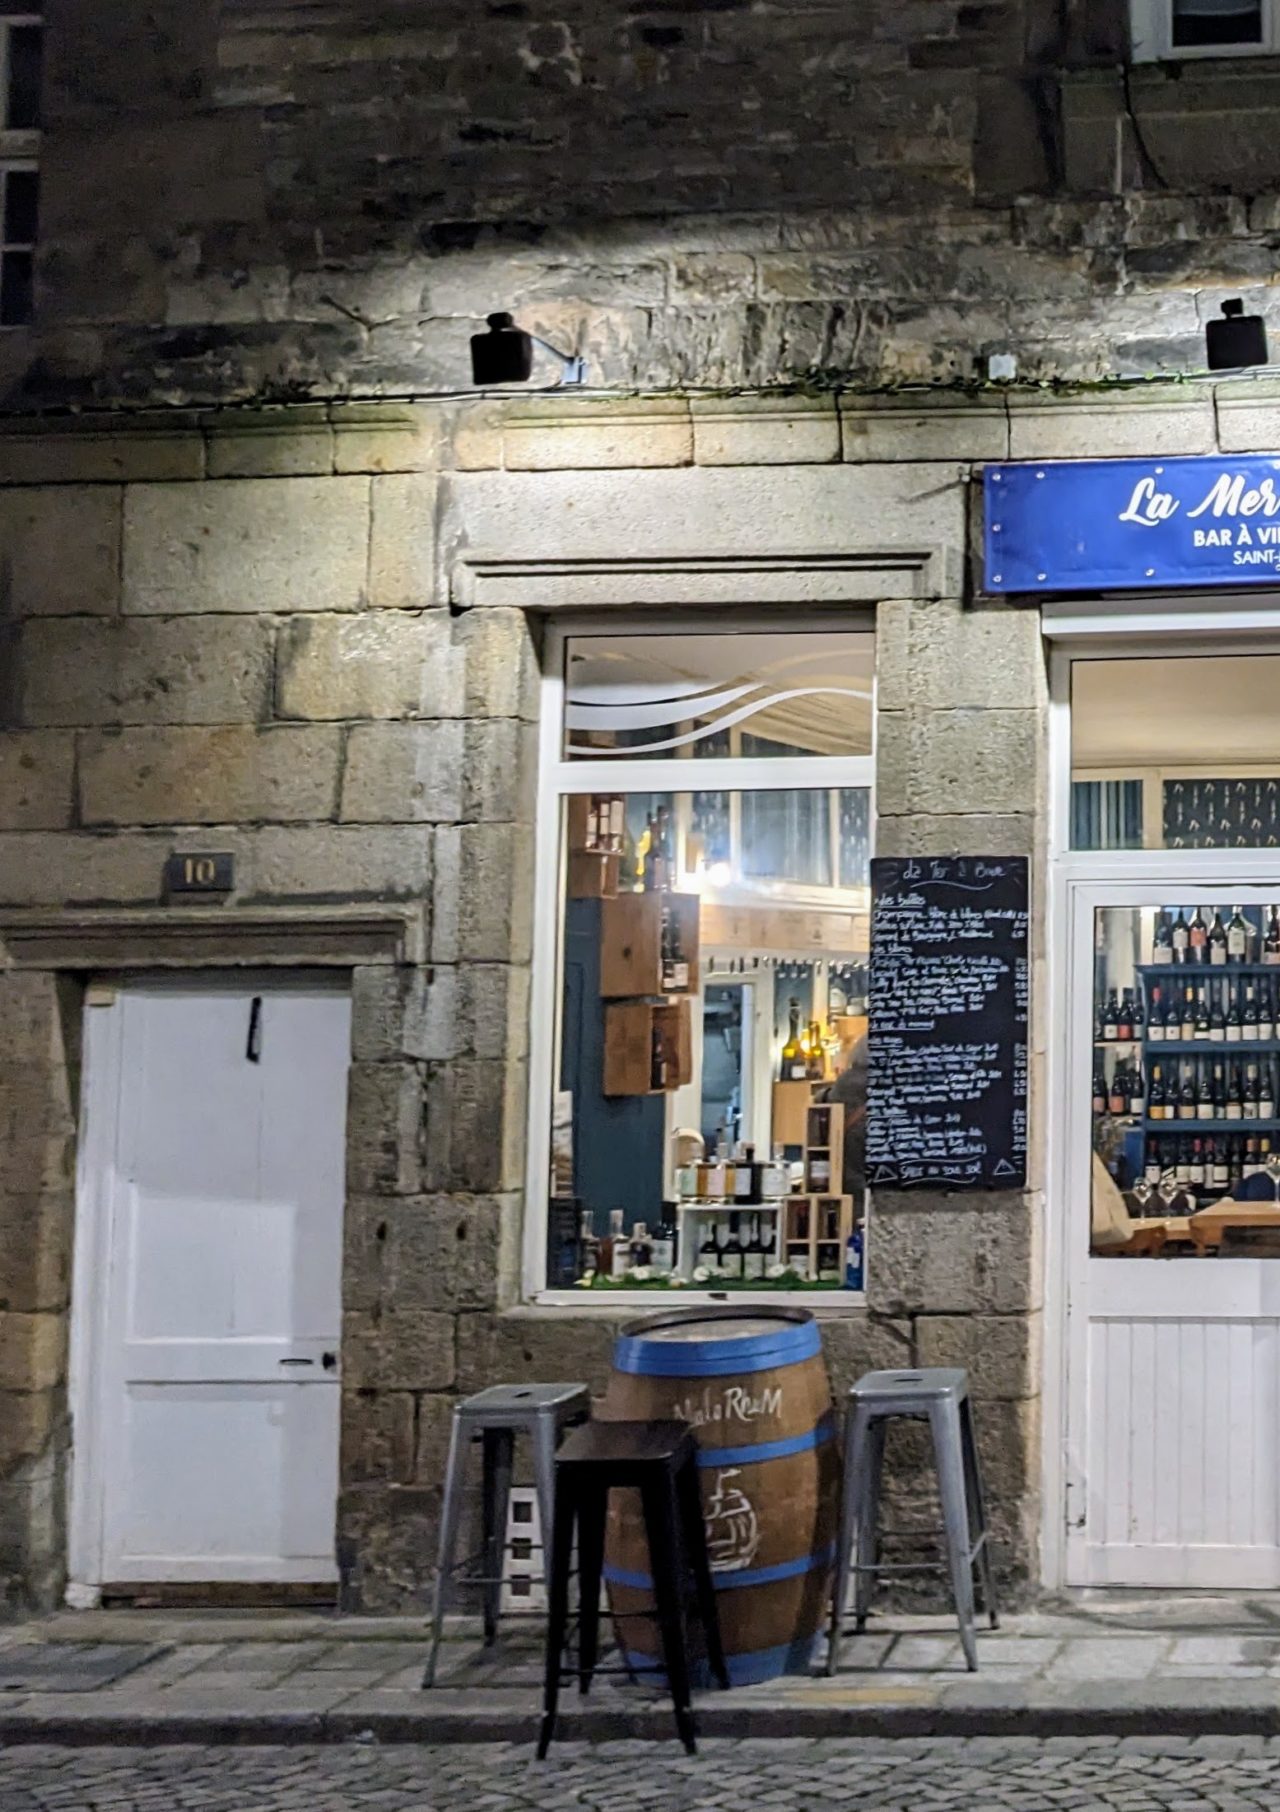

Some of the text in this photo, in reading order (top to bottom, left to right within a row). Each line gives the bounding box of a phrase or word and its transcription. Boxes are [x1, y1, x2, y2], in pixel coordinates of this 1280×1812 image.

[1119, 476, 1180, 527] La
[1194, 527, 1233, 547] BAR
[1237, 522, 1252, 546] À
[185, 858, 215, 885] 10
